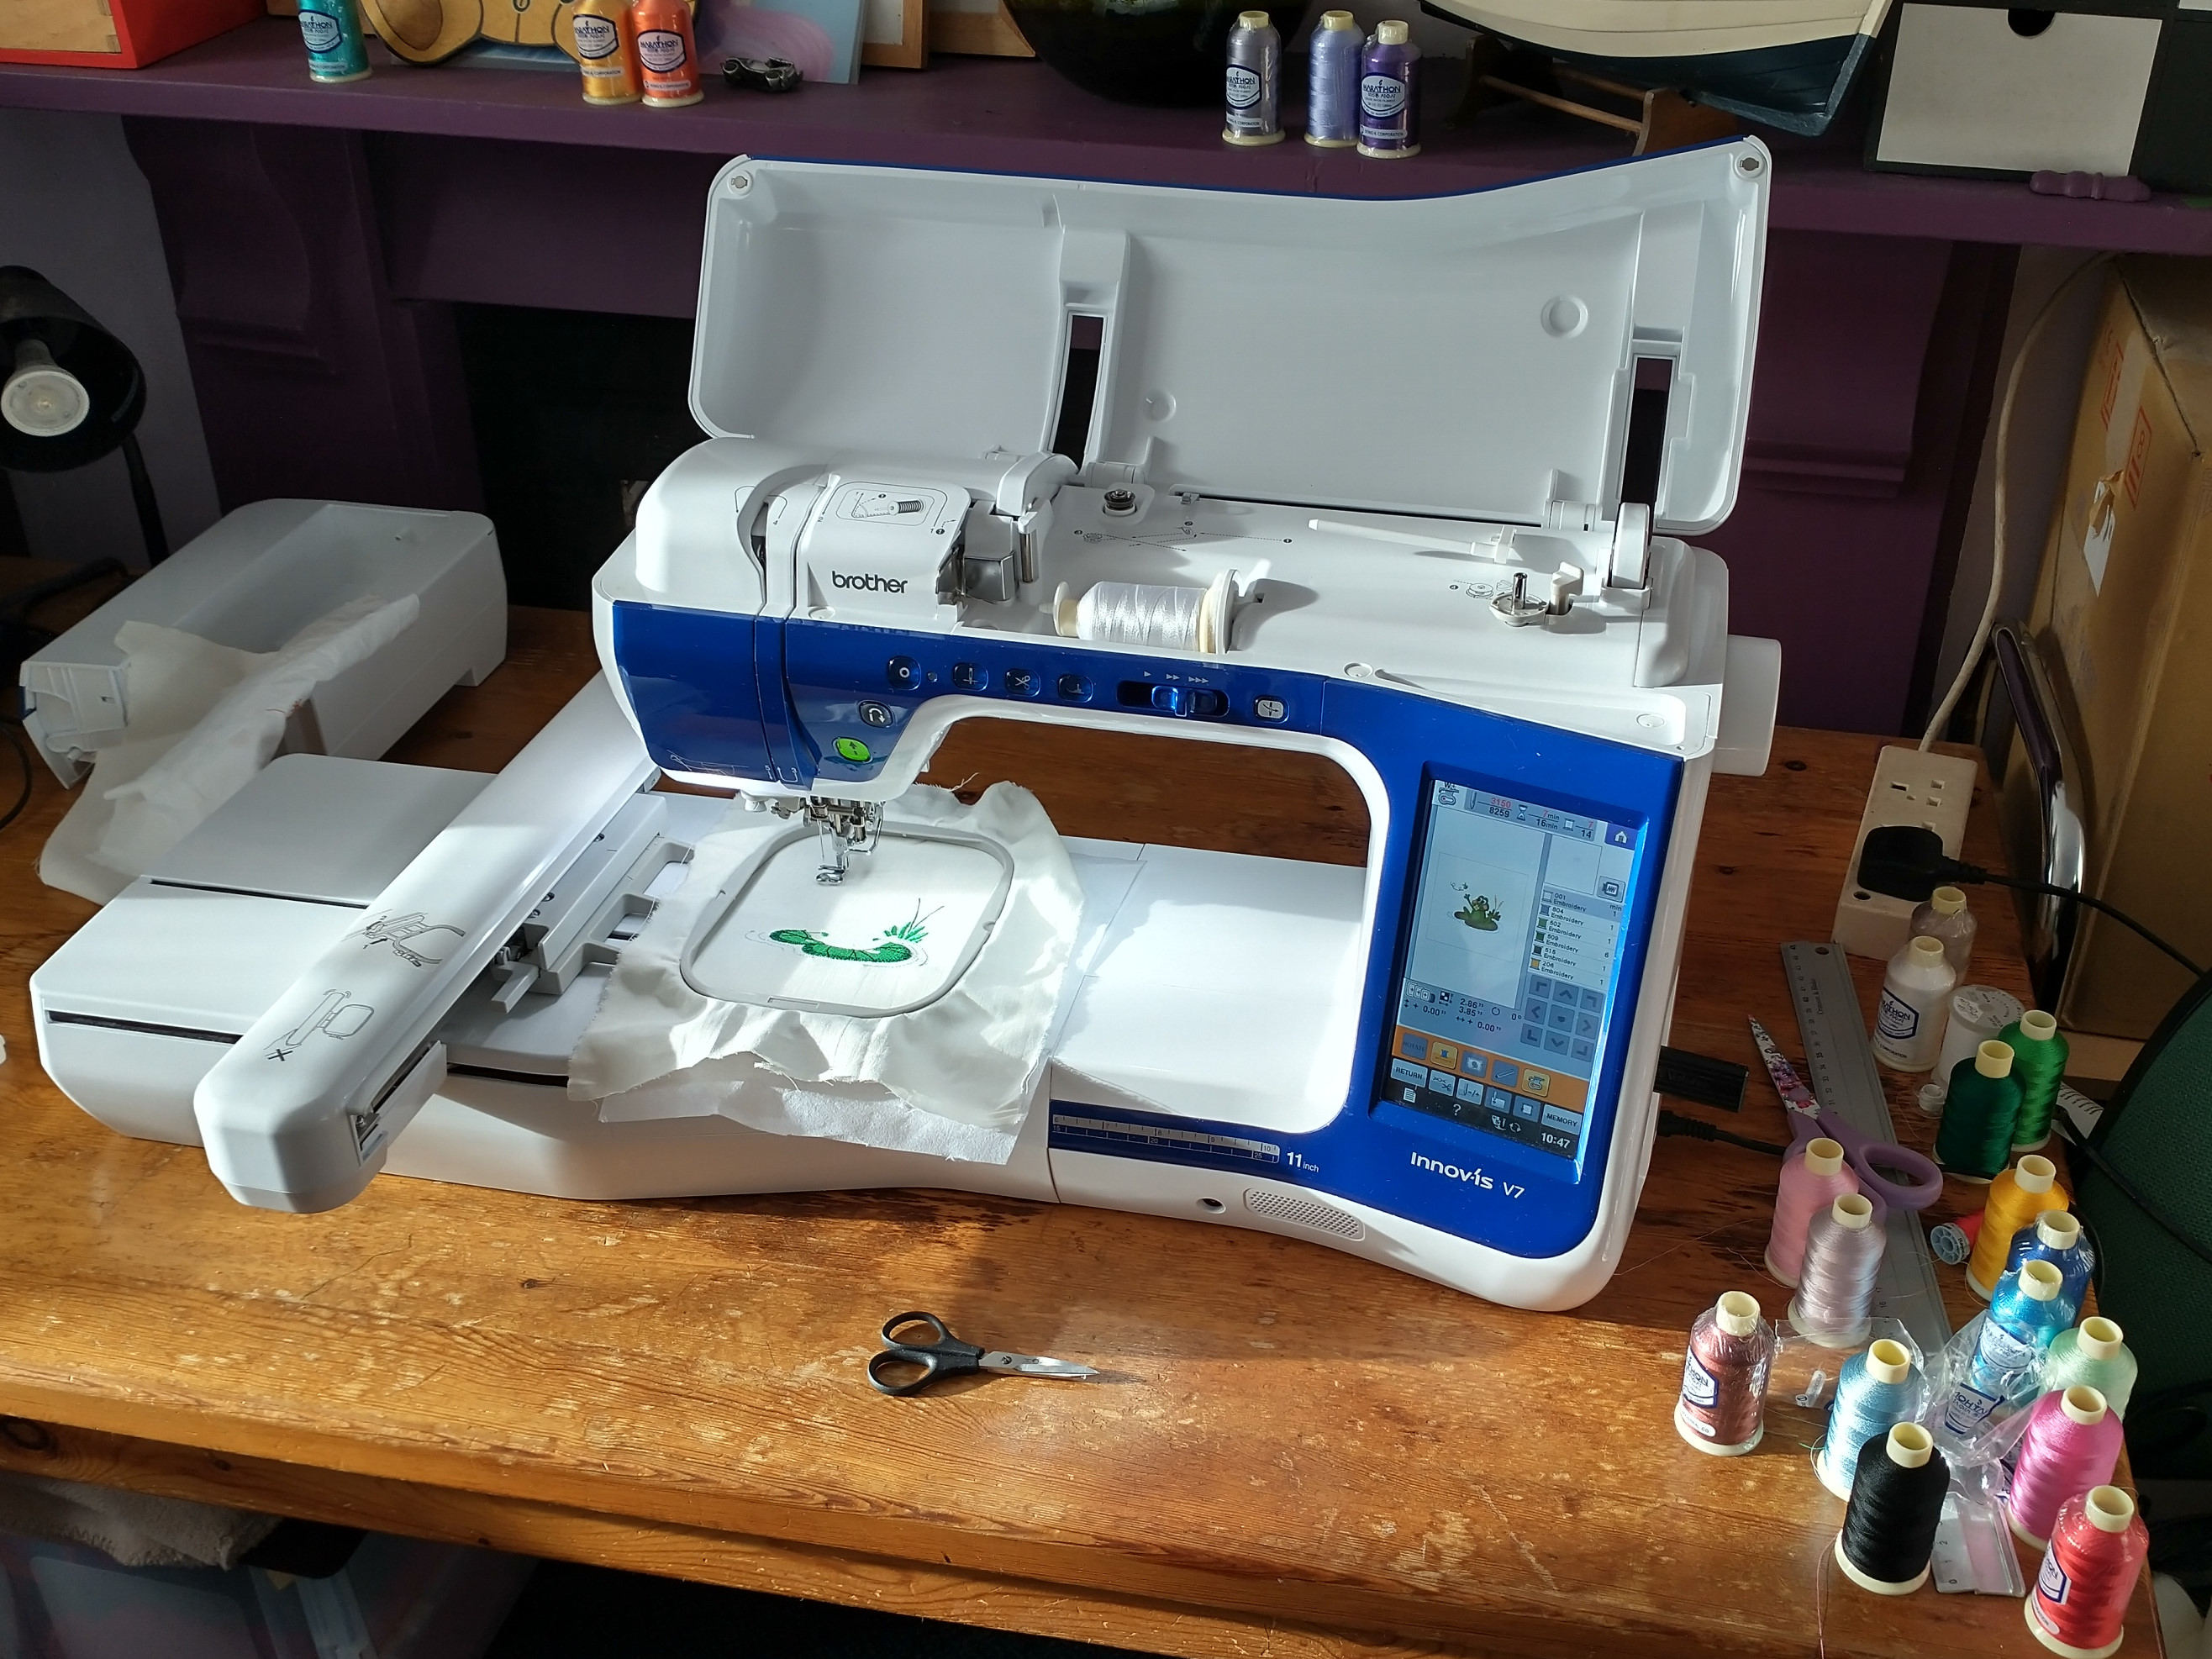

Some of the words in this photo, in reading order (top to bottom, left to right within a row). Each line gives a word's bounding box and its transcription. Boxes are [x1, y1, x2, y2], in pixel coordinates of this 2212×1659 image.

[640, 40, 678, 49] MARATHON
[1363, 84, 1401, 93] MARATHON
[832, 571, 908, 593] brother
[1491, 797, 1512, 808] 3150
[1488, 807, 1510, 819] 8259
[1588, 821, 1594, 830] 7
[1581, 830, 1592, 839] 14
[1555, 893, 1567, 901] 001
[1552, 906, 1564, 914] 804
[1553, 899, 1587, 913] Embroidery
[1551, 913, 1584, 926] Embroidery
[1548, 926, 1582, 940] Embroidery
[1546, 940, 1579, 953] Embroidery
[1543, 953, 1577, 966] Embroidery
[1541, 966, 1574, 981] Embroidery
[1404, 1041, 1425, 1052] ROTATE
[1395, 1066, 1423, 1080] RETURN
[1546, 1113, 1578, 1128] MEMORY
[1541, 1132, 1571, 1150] 10:47
[1503, 1182, 1525, 1199] V7
